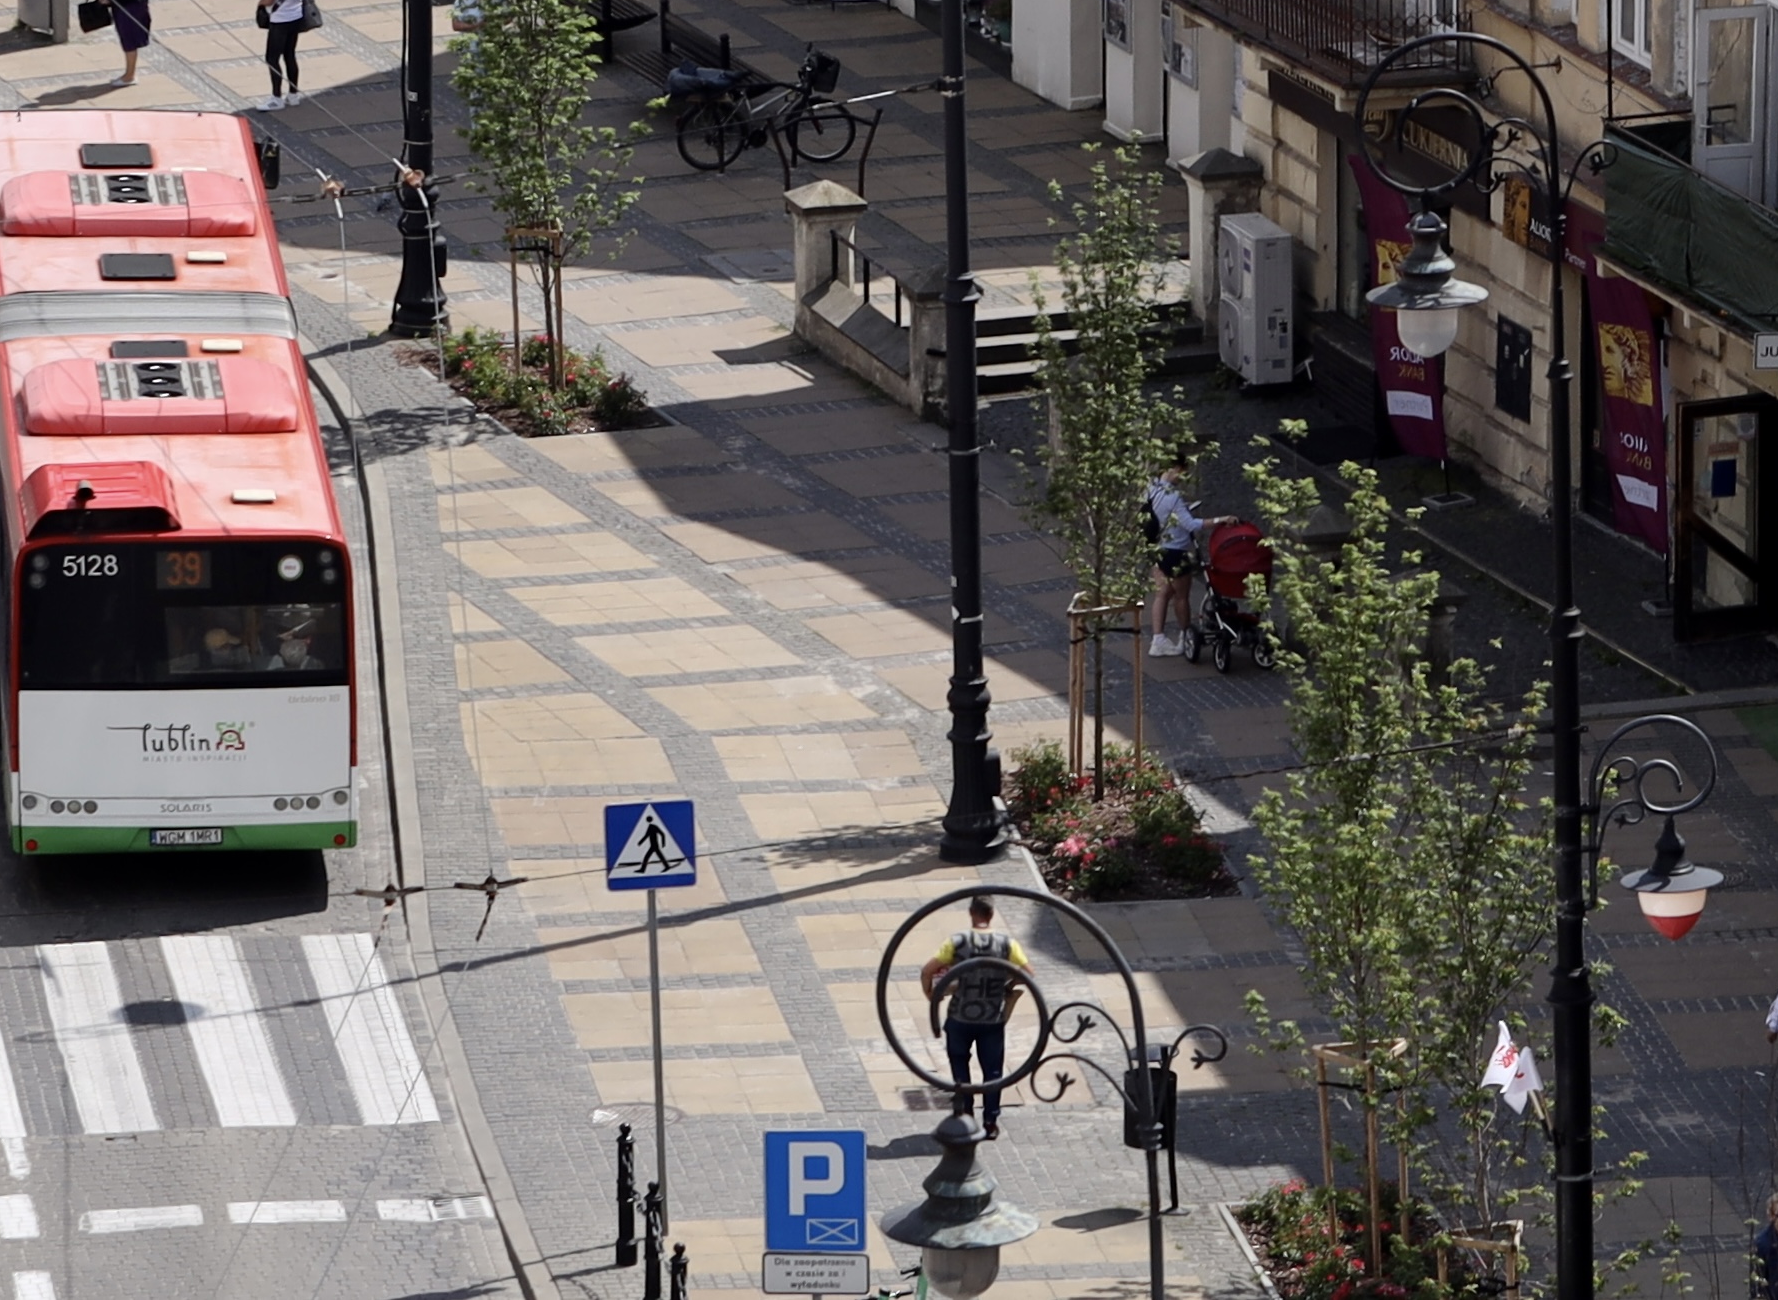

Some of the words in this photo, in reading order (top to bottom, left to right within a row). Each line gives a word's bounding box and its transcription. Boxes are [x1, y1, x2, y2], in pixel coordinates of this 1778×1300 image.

[1401, 120, 1470, 172] CUKIERNIA
[62, 554, 120, 578] 5128
[165, 551, 204, 586] 39
[287, 694, 324, 705] Urbino
[326, 692, 342, 704] 18
[142, 755, 184, 763] MIASTO
[187, 754, 248, 763] INSPIRACJI
[159, 803, 213, 813] SOLARIS
[157, 830, 187, 844] WGM
[189, 829, 221, 843] 1MR1
[788, 1141, 845, 1216] P
[773, 1257, 792, 1267] Dla
[794, 1257, 857, 1269] zaopatrzenia
[795, 1269, 826, 1279] czasie
[789, 1279, 842, 1291] wyładunku
